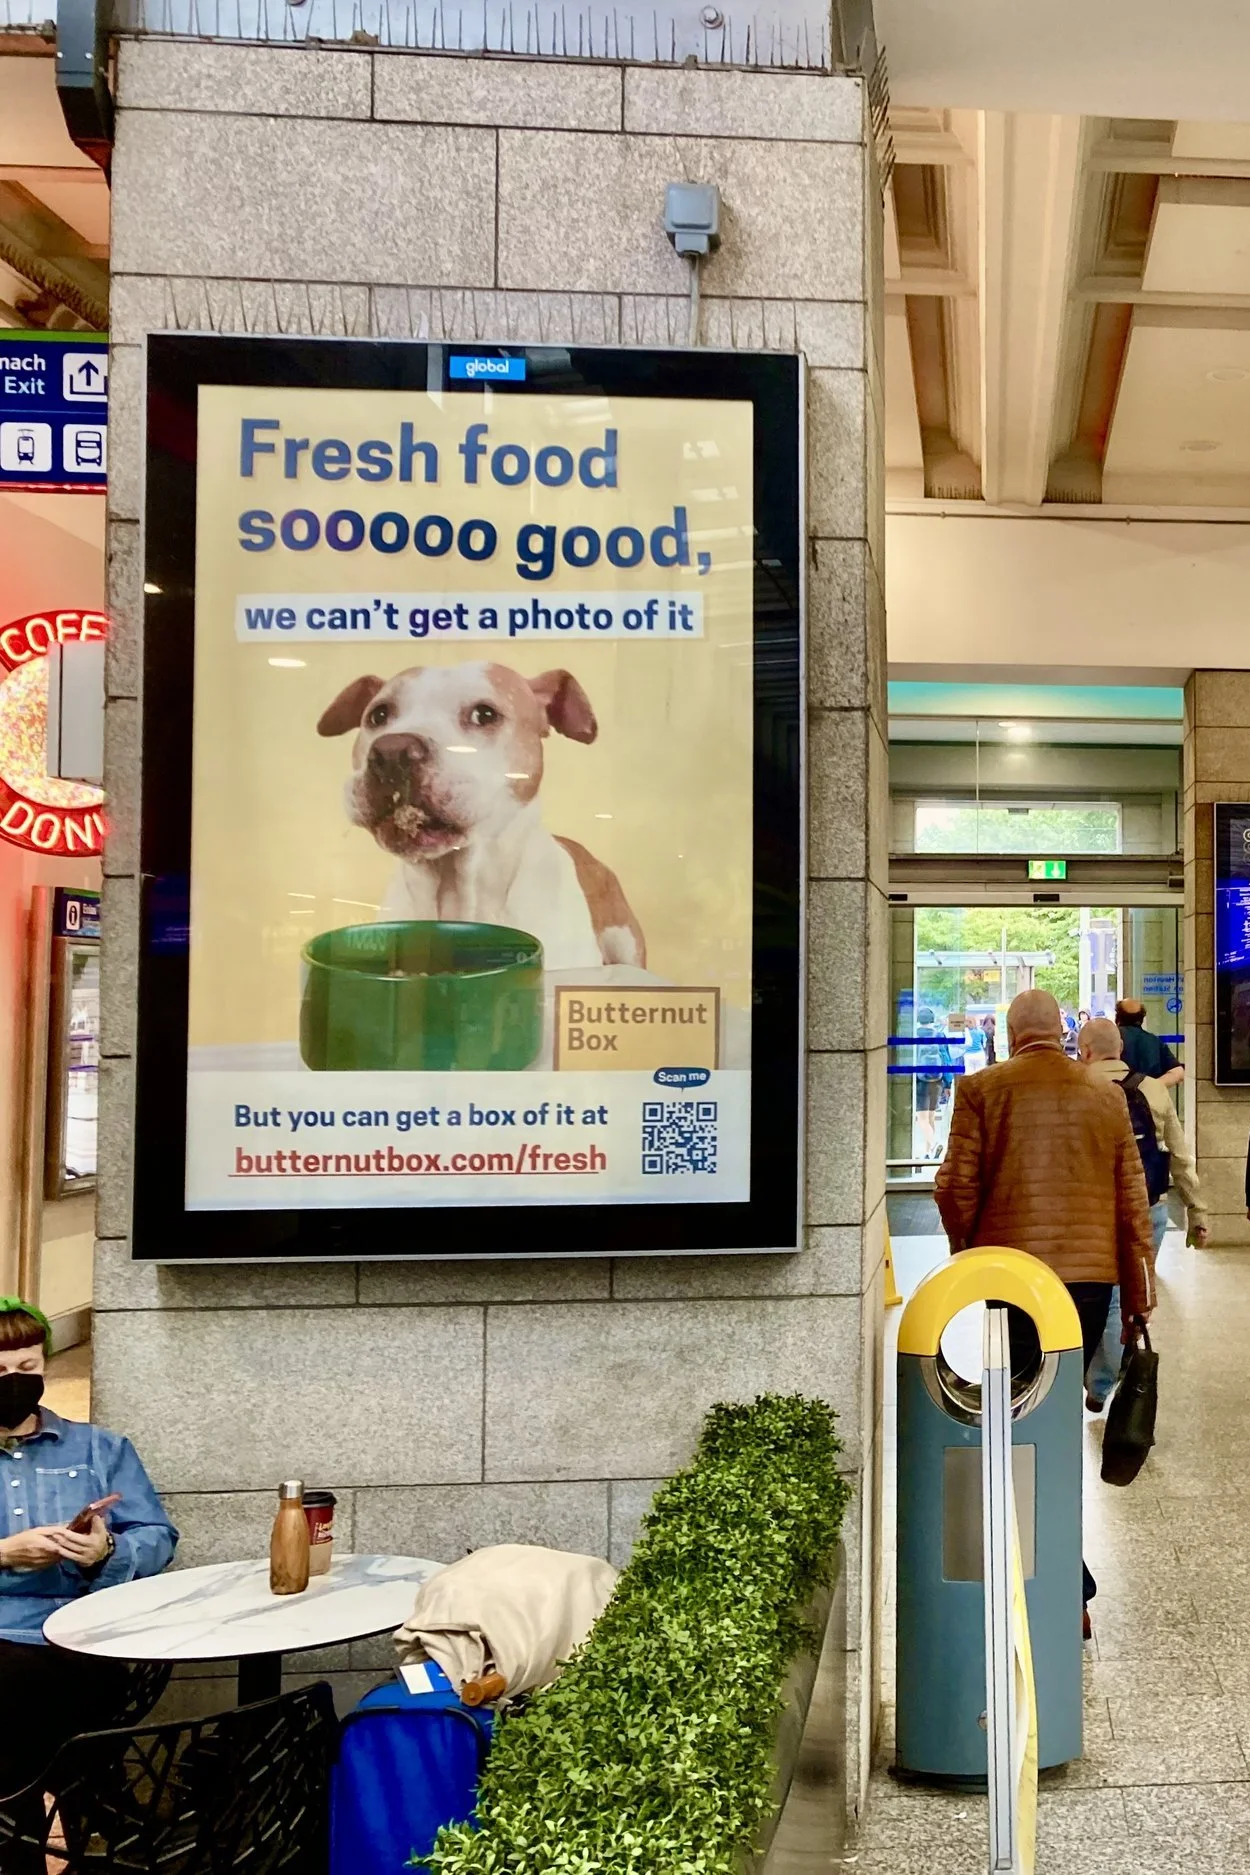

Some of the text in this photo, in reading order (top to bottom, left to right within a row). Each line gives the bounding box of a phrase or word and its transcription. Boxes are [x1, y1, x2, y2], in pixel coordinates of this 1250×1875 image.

[466, 357, 510, 376] global
[4, 376, 46, 395] Exit
[240, 418, 619, 488] Fresh food
[238, 506, 711, 580] sooooo good,
[245, 600, 694, 637] we can't get a photo of it
[0, 800, 108, 852] DON
[568, 1000, 708, 1025] Butternut
[567, 1028, 619, 1052] Box
[658, 1072, 706, 1082] Scan me
[234, 1103, 608, 1133] But you can get a box of it at
[235, 1144, 607, 1175] butternutbox.com/fresh
